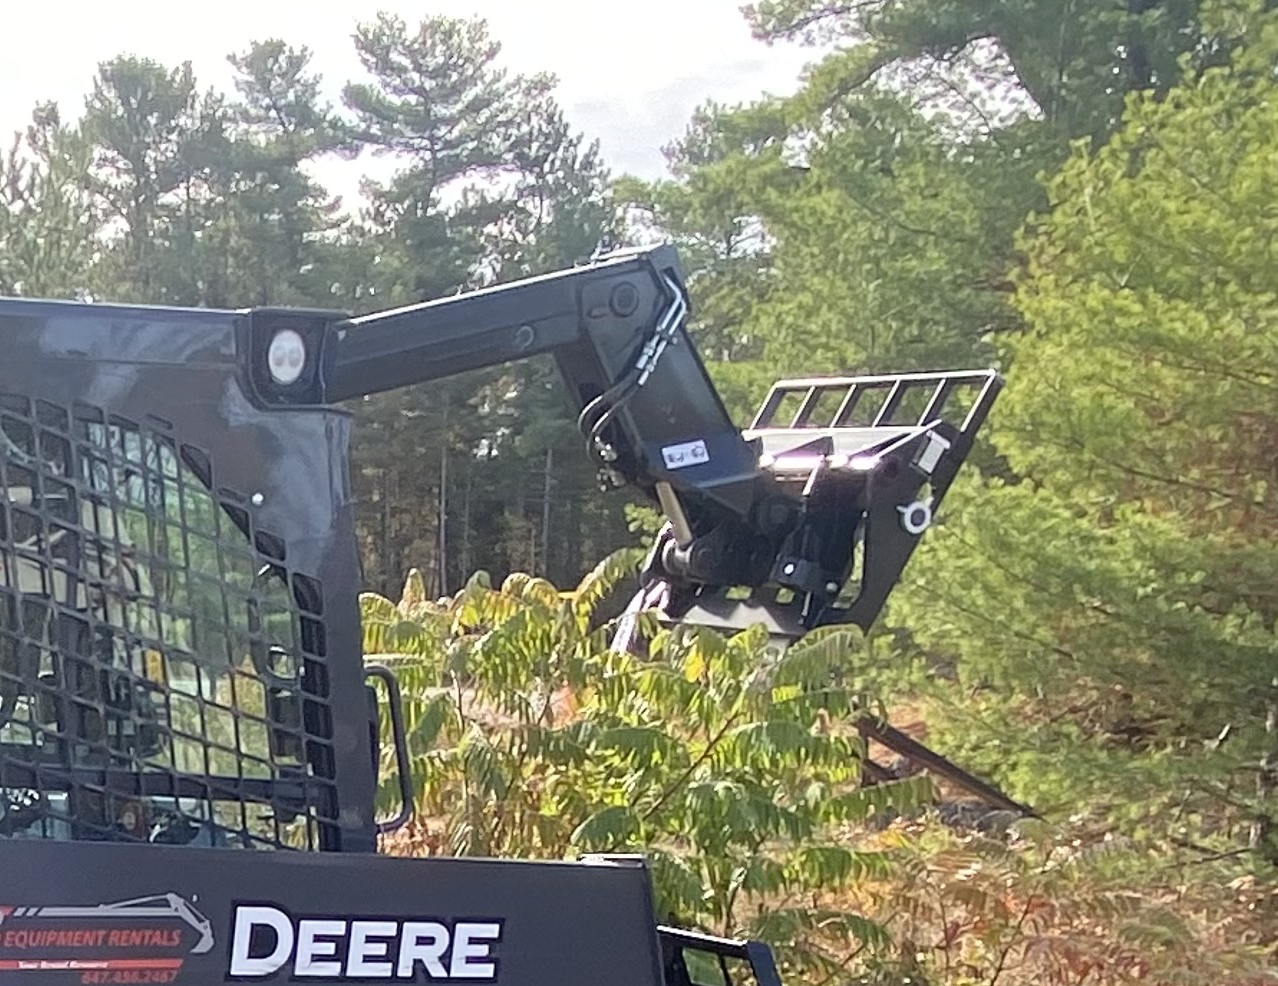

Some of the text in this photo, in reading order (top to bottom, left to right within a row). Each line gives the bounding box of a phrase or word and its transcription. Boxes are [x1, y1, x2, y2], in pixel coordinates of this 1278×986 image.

[3, 929, 107, 949] EQUIPMENT
[109, 928, 183, 948] RENTALS
[229, 905, 501, 979] DEERE
